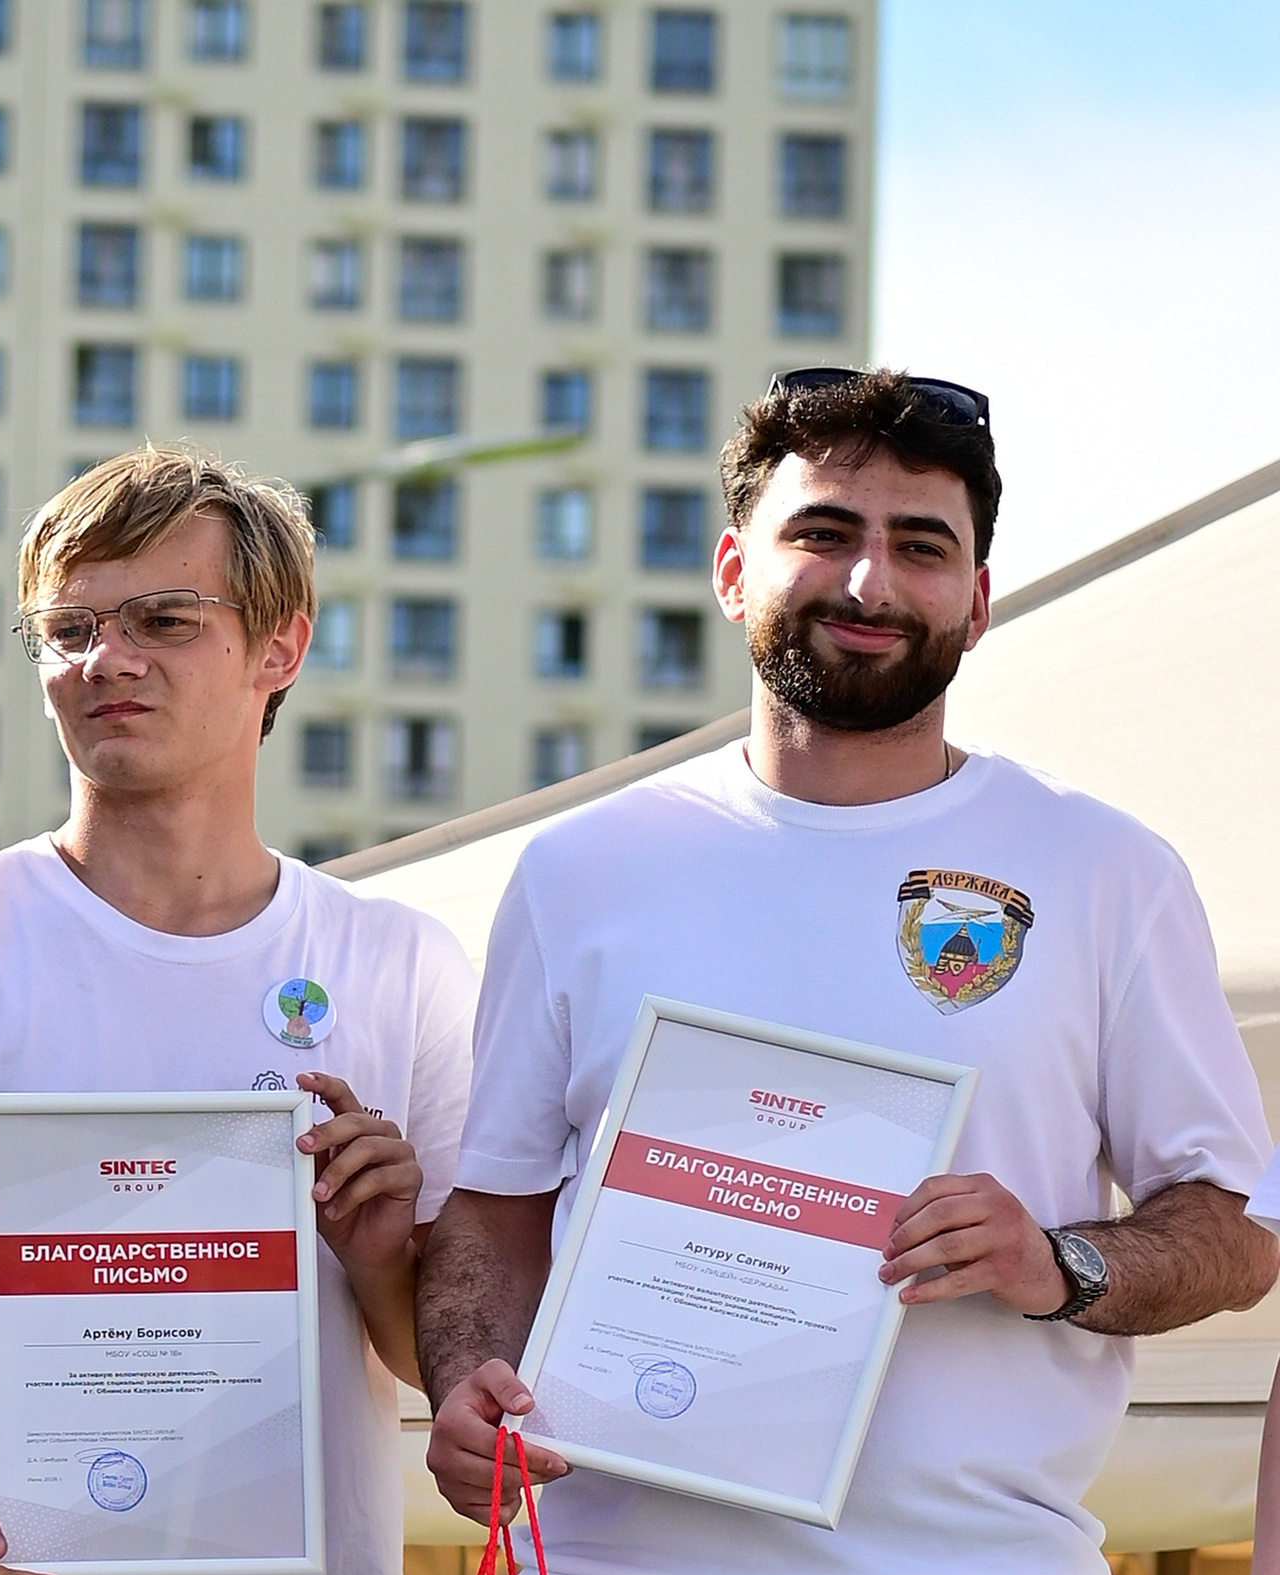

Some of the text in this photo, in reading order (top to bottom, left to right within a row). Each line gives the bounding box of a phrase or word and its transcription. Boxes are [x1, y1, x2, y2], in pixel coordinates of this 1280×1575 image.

[931, 872, 1010, 899] ДЕРЖАВА
[748, 1090, 826, 1118] SINTEC
[756, 1113, 807, 1131] GROUP
[99, 1160, 177, 1175] SINTEC
[112, 1183, 164, 1192] GROUP
[645, 1148, 879, 1215] БЛАГОДАРСТВЕННОЕ
[707, 1185, 800, 1220] ПИСЬМО
[20, 1241, 259, 1263] БЛАГОДАРСТВЕННОЕ
[683, 1240, 790, 1275] Артуру Сагияну
[93, 1266, 187, 1284] ПИСЬМО
[82, 1327, 202, 1341] Артёму Борисову
